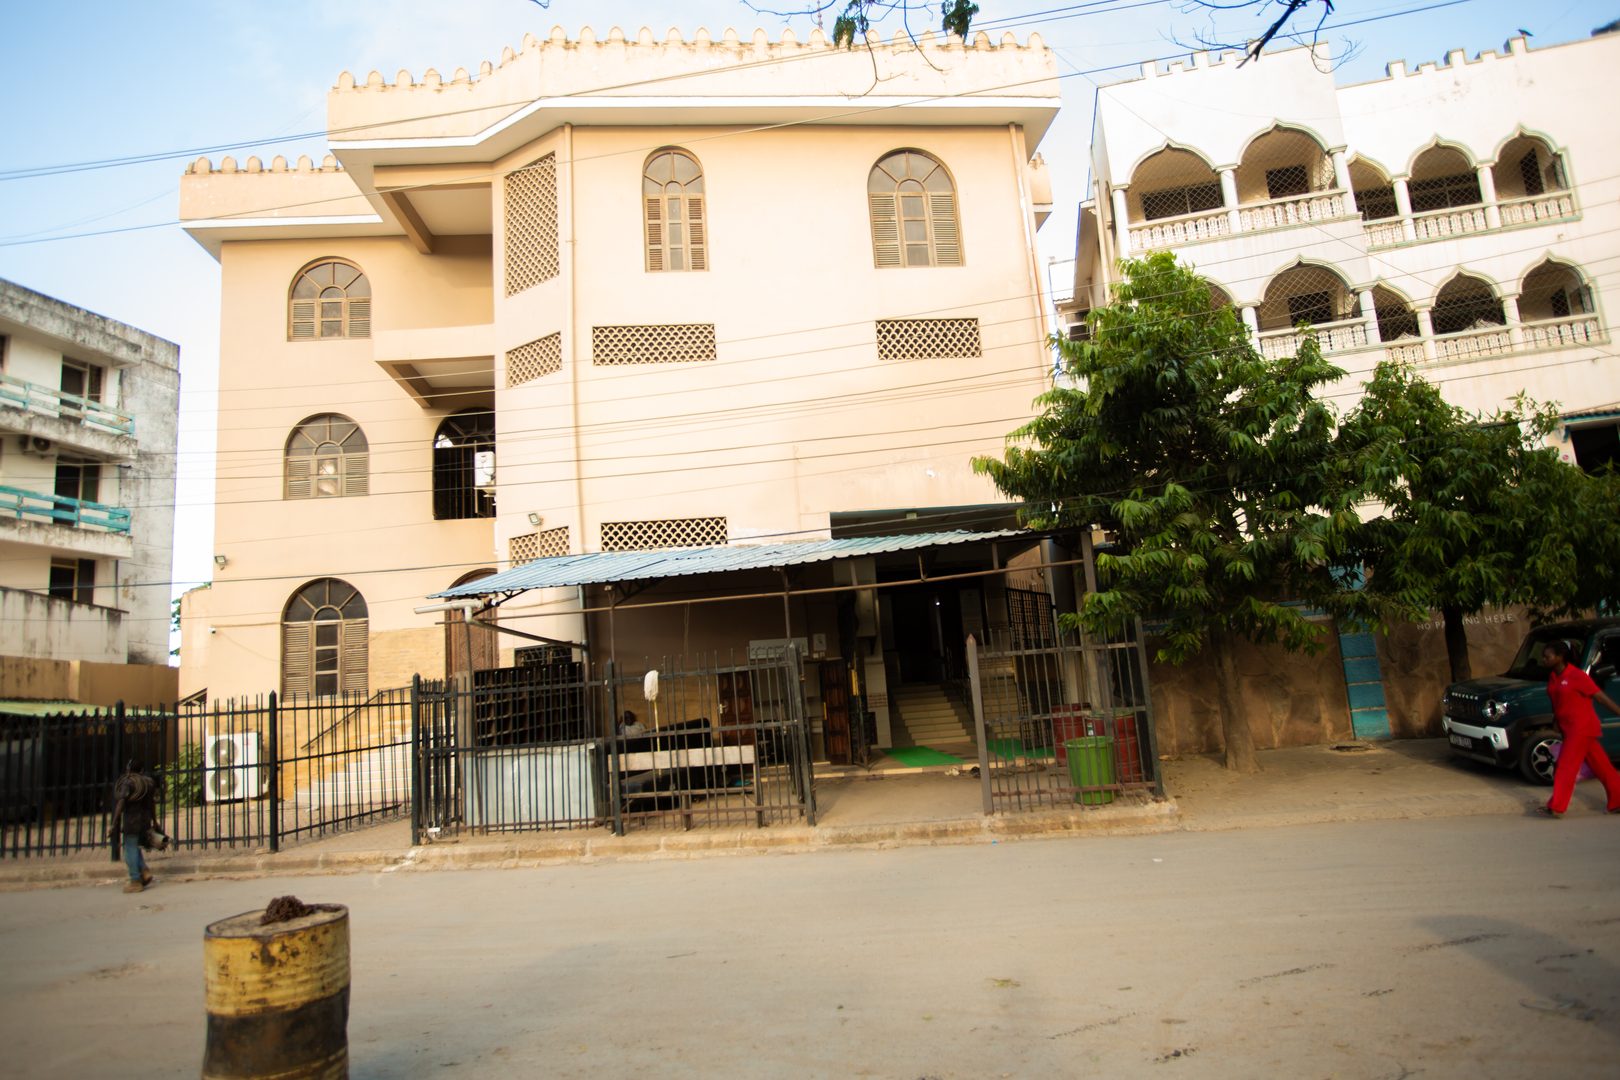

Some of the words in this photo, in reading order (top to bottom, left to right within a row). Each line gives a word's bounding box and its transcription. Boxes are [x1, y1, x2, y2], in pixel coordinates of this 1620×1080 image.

[1416, 622, 1431, 631] NO
[1435, 616, 1480, 631] PING
[1484, 613, 1513, 624] HERE
